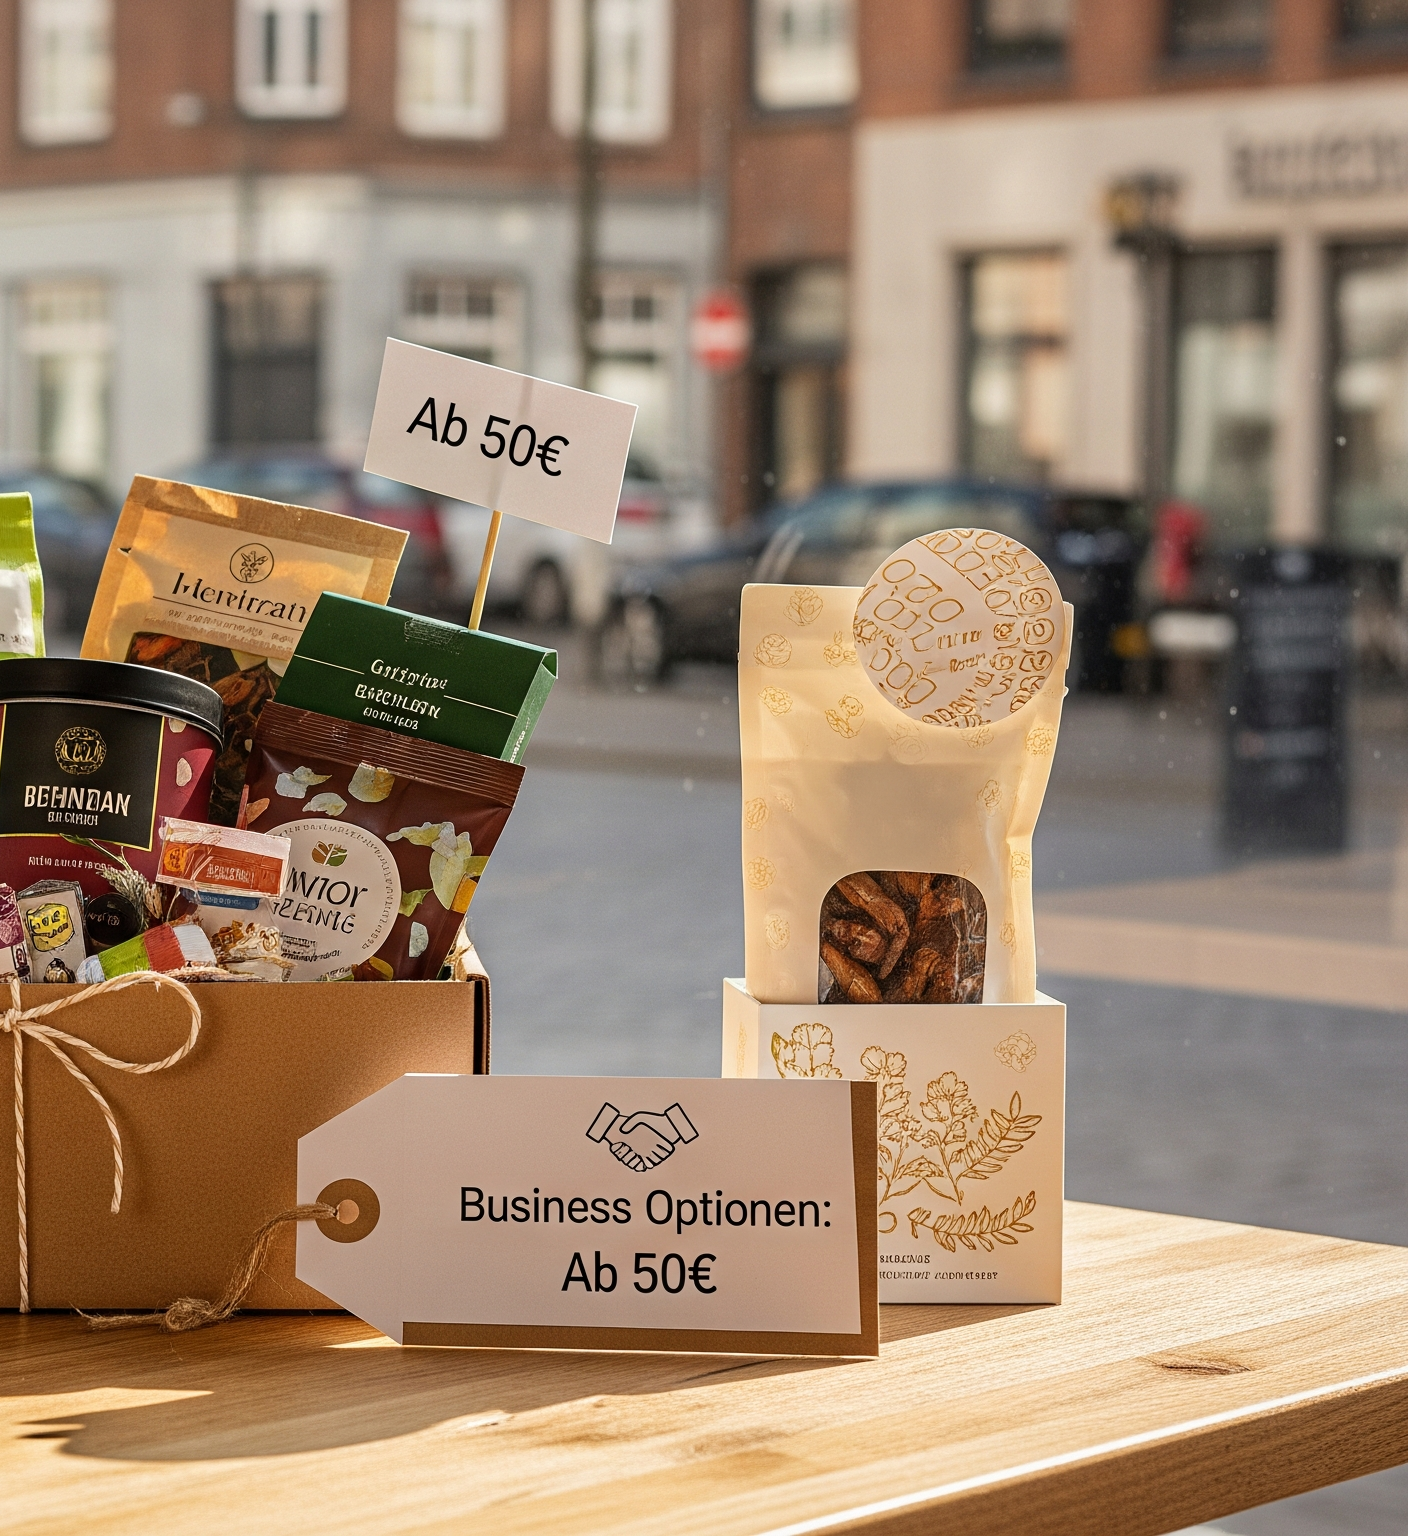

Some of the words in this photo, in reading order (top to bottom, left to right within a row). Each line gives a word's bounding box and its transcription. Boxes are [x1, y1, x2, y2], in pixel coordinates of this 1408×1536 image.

[406, 396, 468, 447] Ab
[479, 414, 570, 477] 50€
[460, 1186, 632, 1225] Business
[645, 1189, 831, 1235] Optionen:
[561, 1250, 618, 1293] Ab
[633, 1252, 718, 1295] 50€
